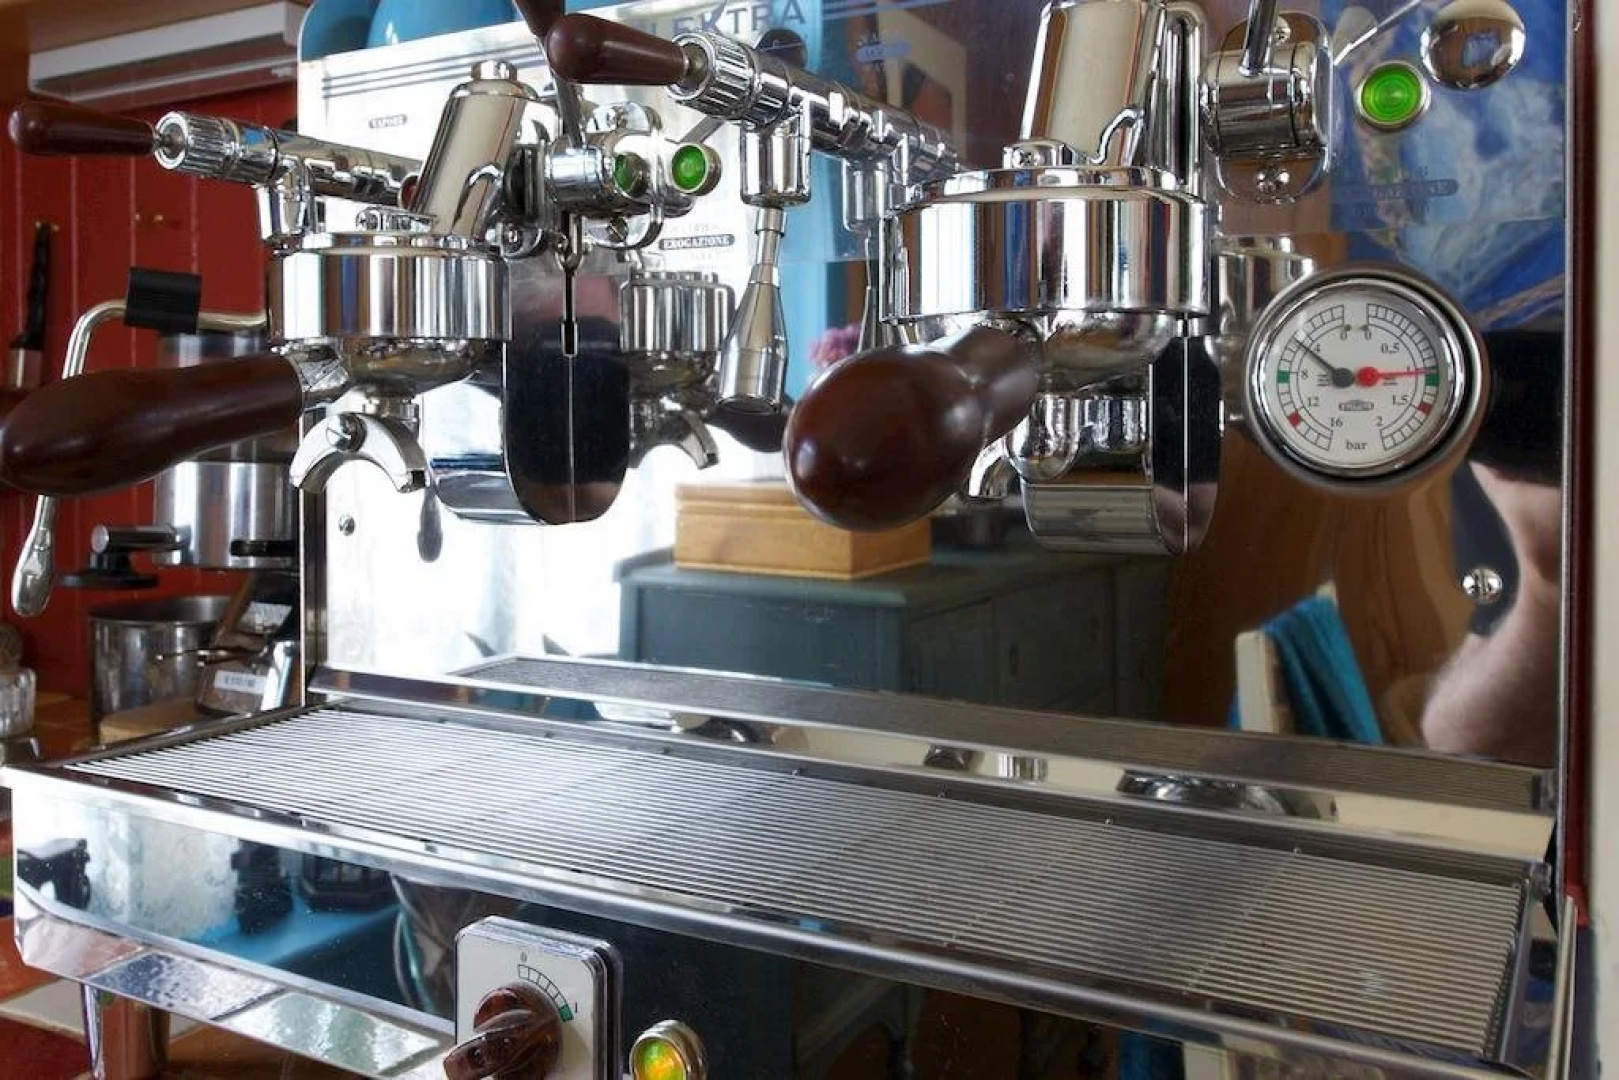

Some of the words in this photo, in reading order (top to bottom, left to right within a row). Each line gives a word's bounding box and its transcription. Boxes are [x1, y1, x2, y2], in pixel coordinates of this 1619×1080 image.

[1340, 330, 1348, 341] 0
[1364, 330, 1372, 340] 0
[1300, 369, 1308, 379] 8
[1308, 396, 1320, 407] 12
[1330, 417, 1343, 428] 16
[1376, 415, 1384, 427] 2
[1345, 440, 1368, 451] bar
